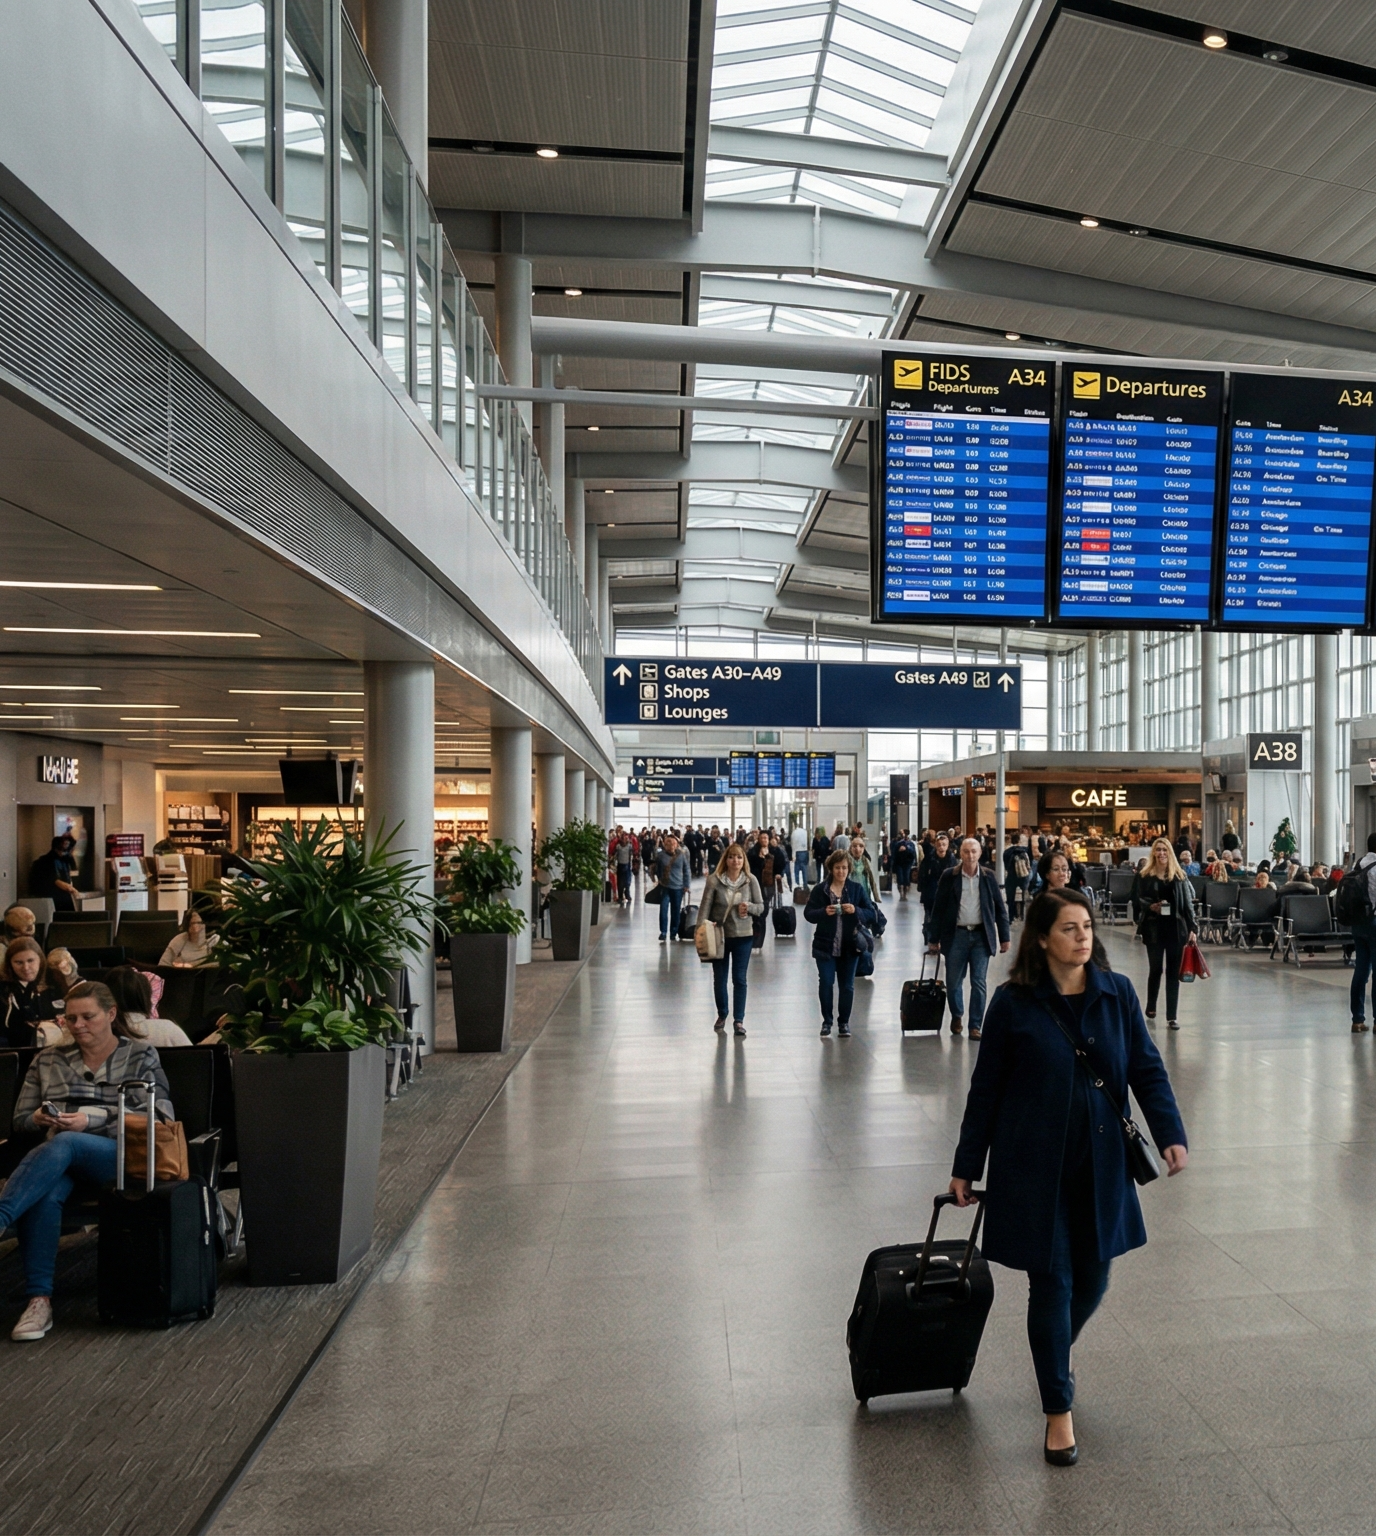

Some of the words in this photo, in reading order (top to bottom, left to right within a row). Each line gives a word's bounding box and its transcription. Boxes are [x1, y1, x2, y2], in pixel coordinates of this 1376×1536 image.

[929, 362, 971, 381] FIDS
[1007, 368, 1047, 386] A34
[1106, 376, 1207, 399] Departures
[1337, 389, 1374, 407] A34
[664, 664, 709, 680] Gates
[711, 665, 782, 681] A30–A49
[938, 671, 968, 685] A49
[664, 683, 710, 702] Shops
[664, 704, 729, 723] Lounges
[1253, 740, 1298, 762] A38
